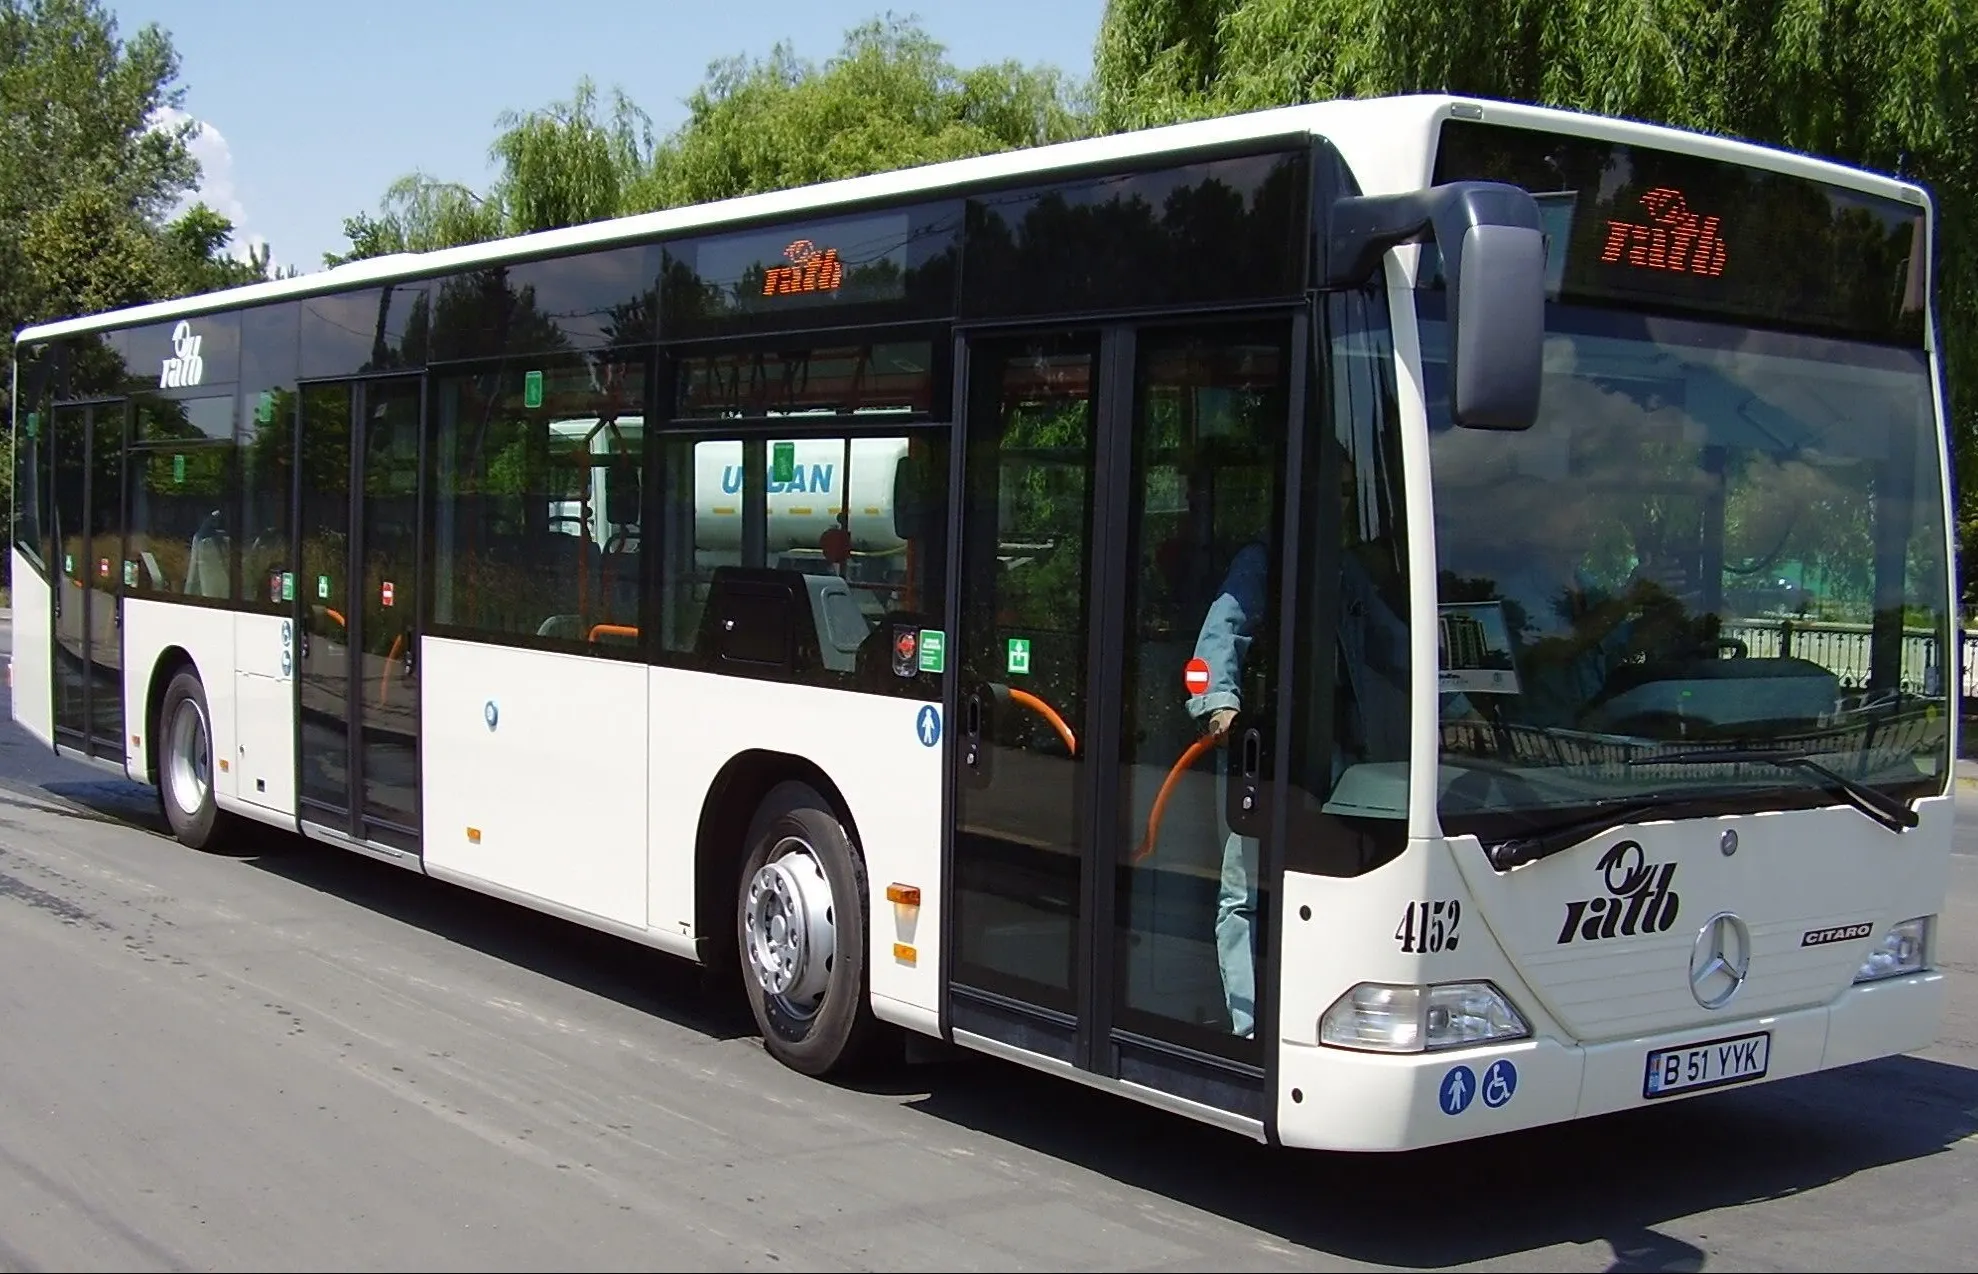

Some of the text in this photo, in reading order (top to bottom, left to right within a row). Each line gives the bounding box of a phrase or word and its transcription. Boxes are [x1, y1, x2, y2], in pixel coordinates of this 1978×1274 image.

[721, 464, 834, 495] UBAN
[1395, 900, 1461, 953] 4152
[1804, 925, 1871, 945] CITARO
[1663, 1054, 1681, 1086] B
[1686, 1049, 1709, 1081] 51
[1718, 1040, 1760, 1076] YYK
